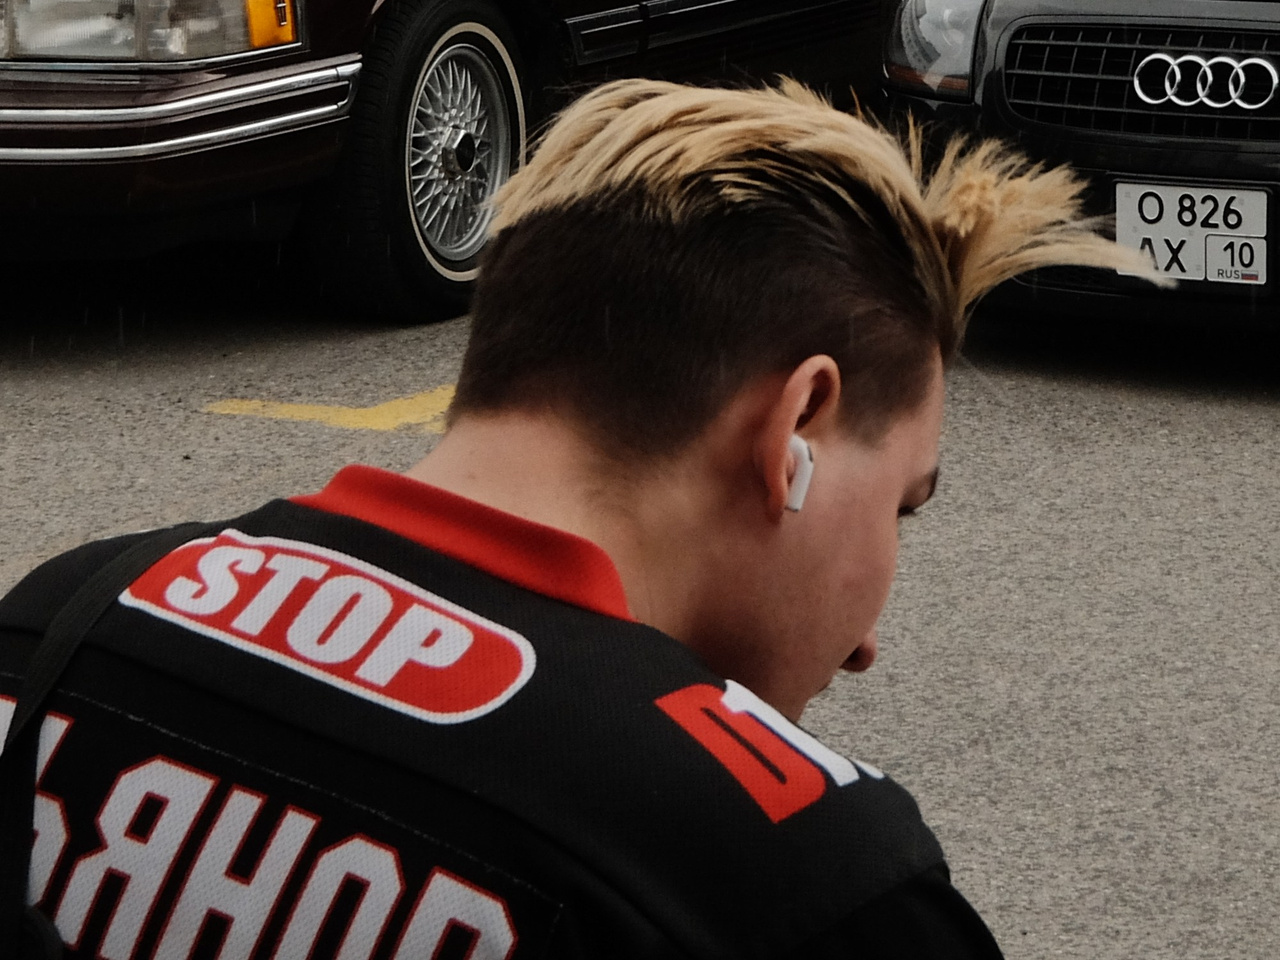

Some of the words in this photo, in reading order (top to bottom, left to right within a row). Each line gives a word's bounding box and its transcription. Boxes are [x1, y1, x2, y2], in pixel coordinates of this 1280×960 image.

[1177, 193, 1243, 229] 826
[1223, 240, 1255, 268] 10
[1217, 268, 1240, 279] RUS
[164, 545, 475, 688] STOP
